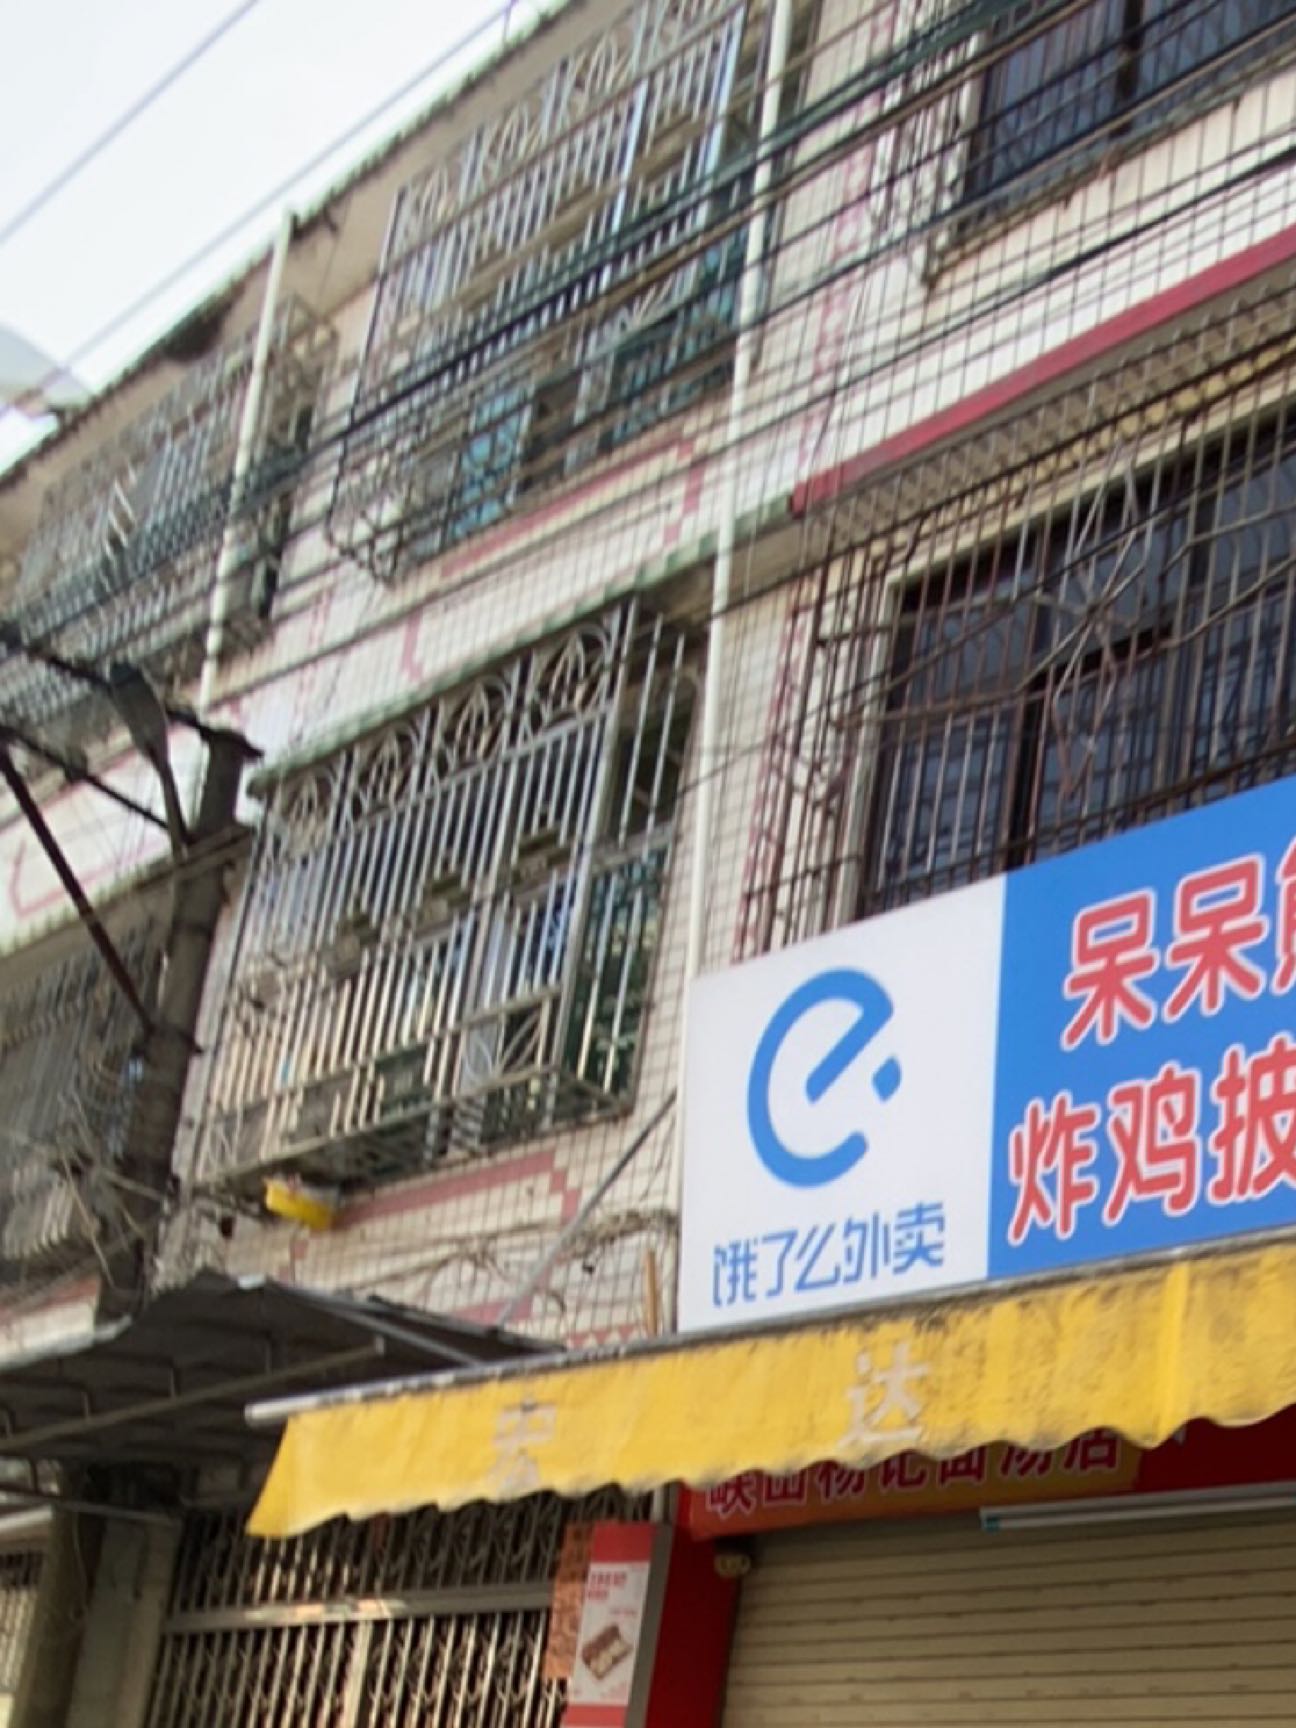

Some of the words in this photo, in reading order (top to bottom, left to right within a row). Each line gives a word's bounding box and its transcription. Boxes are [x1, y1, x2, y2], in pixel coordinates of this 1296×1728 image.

[712, 1203, 947, 1309] 饿了么外卖
